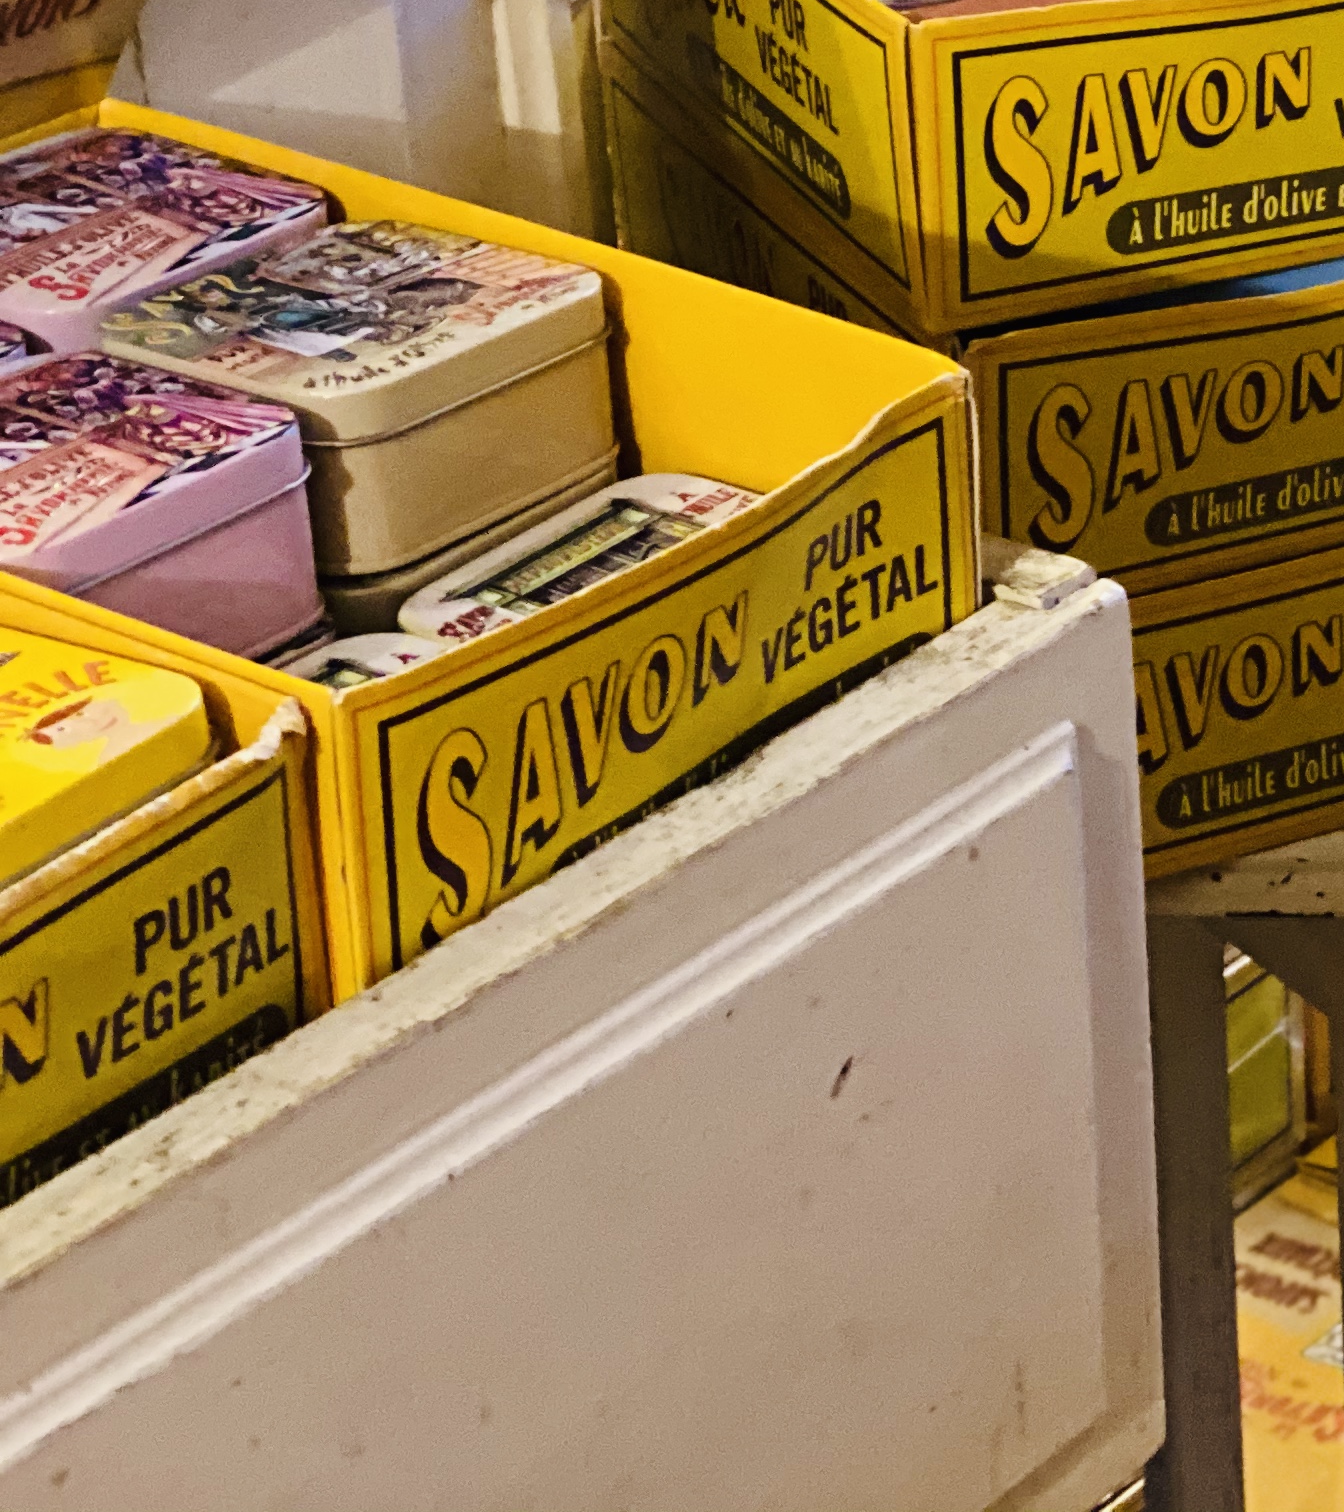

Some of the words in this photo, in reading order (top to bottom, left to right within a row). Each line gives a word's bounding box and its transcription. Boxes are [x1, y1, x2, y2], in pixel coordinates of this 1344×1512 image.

[754, 23, 840, 138] VÉGÉTAL
[984, 46, 1313, 258] SAVON
[759, 541, 939, 688] VÉGÉTAL
[803, 498, 883, 594] PUR
[418, 589, 751, 952] SAVON
[132, 866, 233, 978] PUR
[76, 918, 291, 1080] VÉGÉTAL
